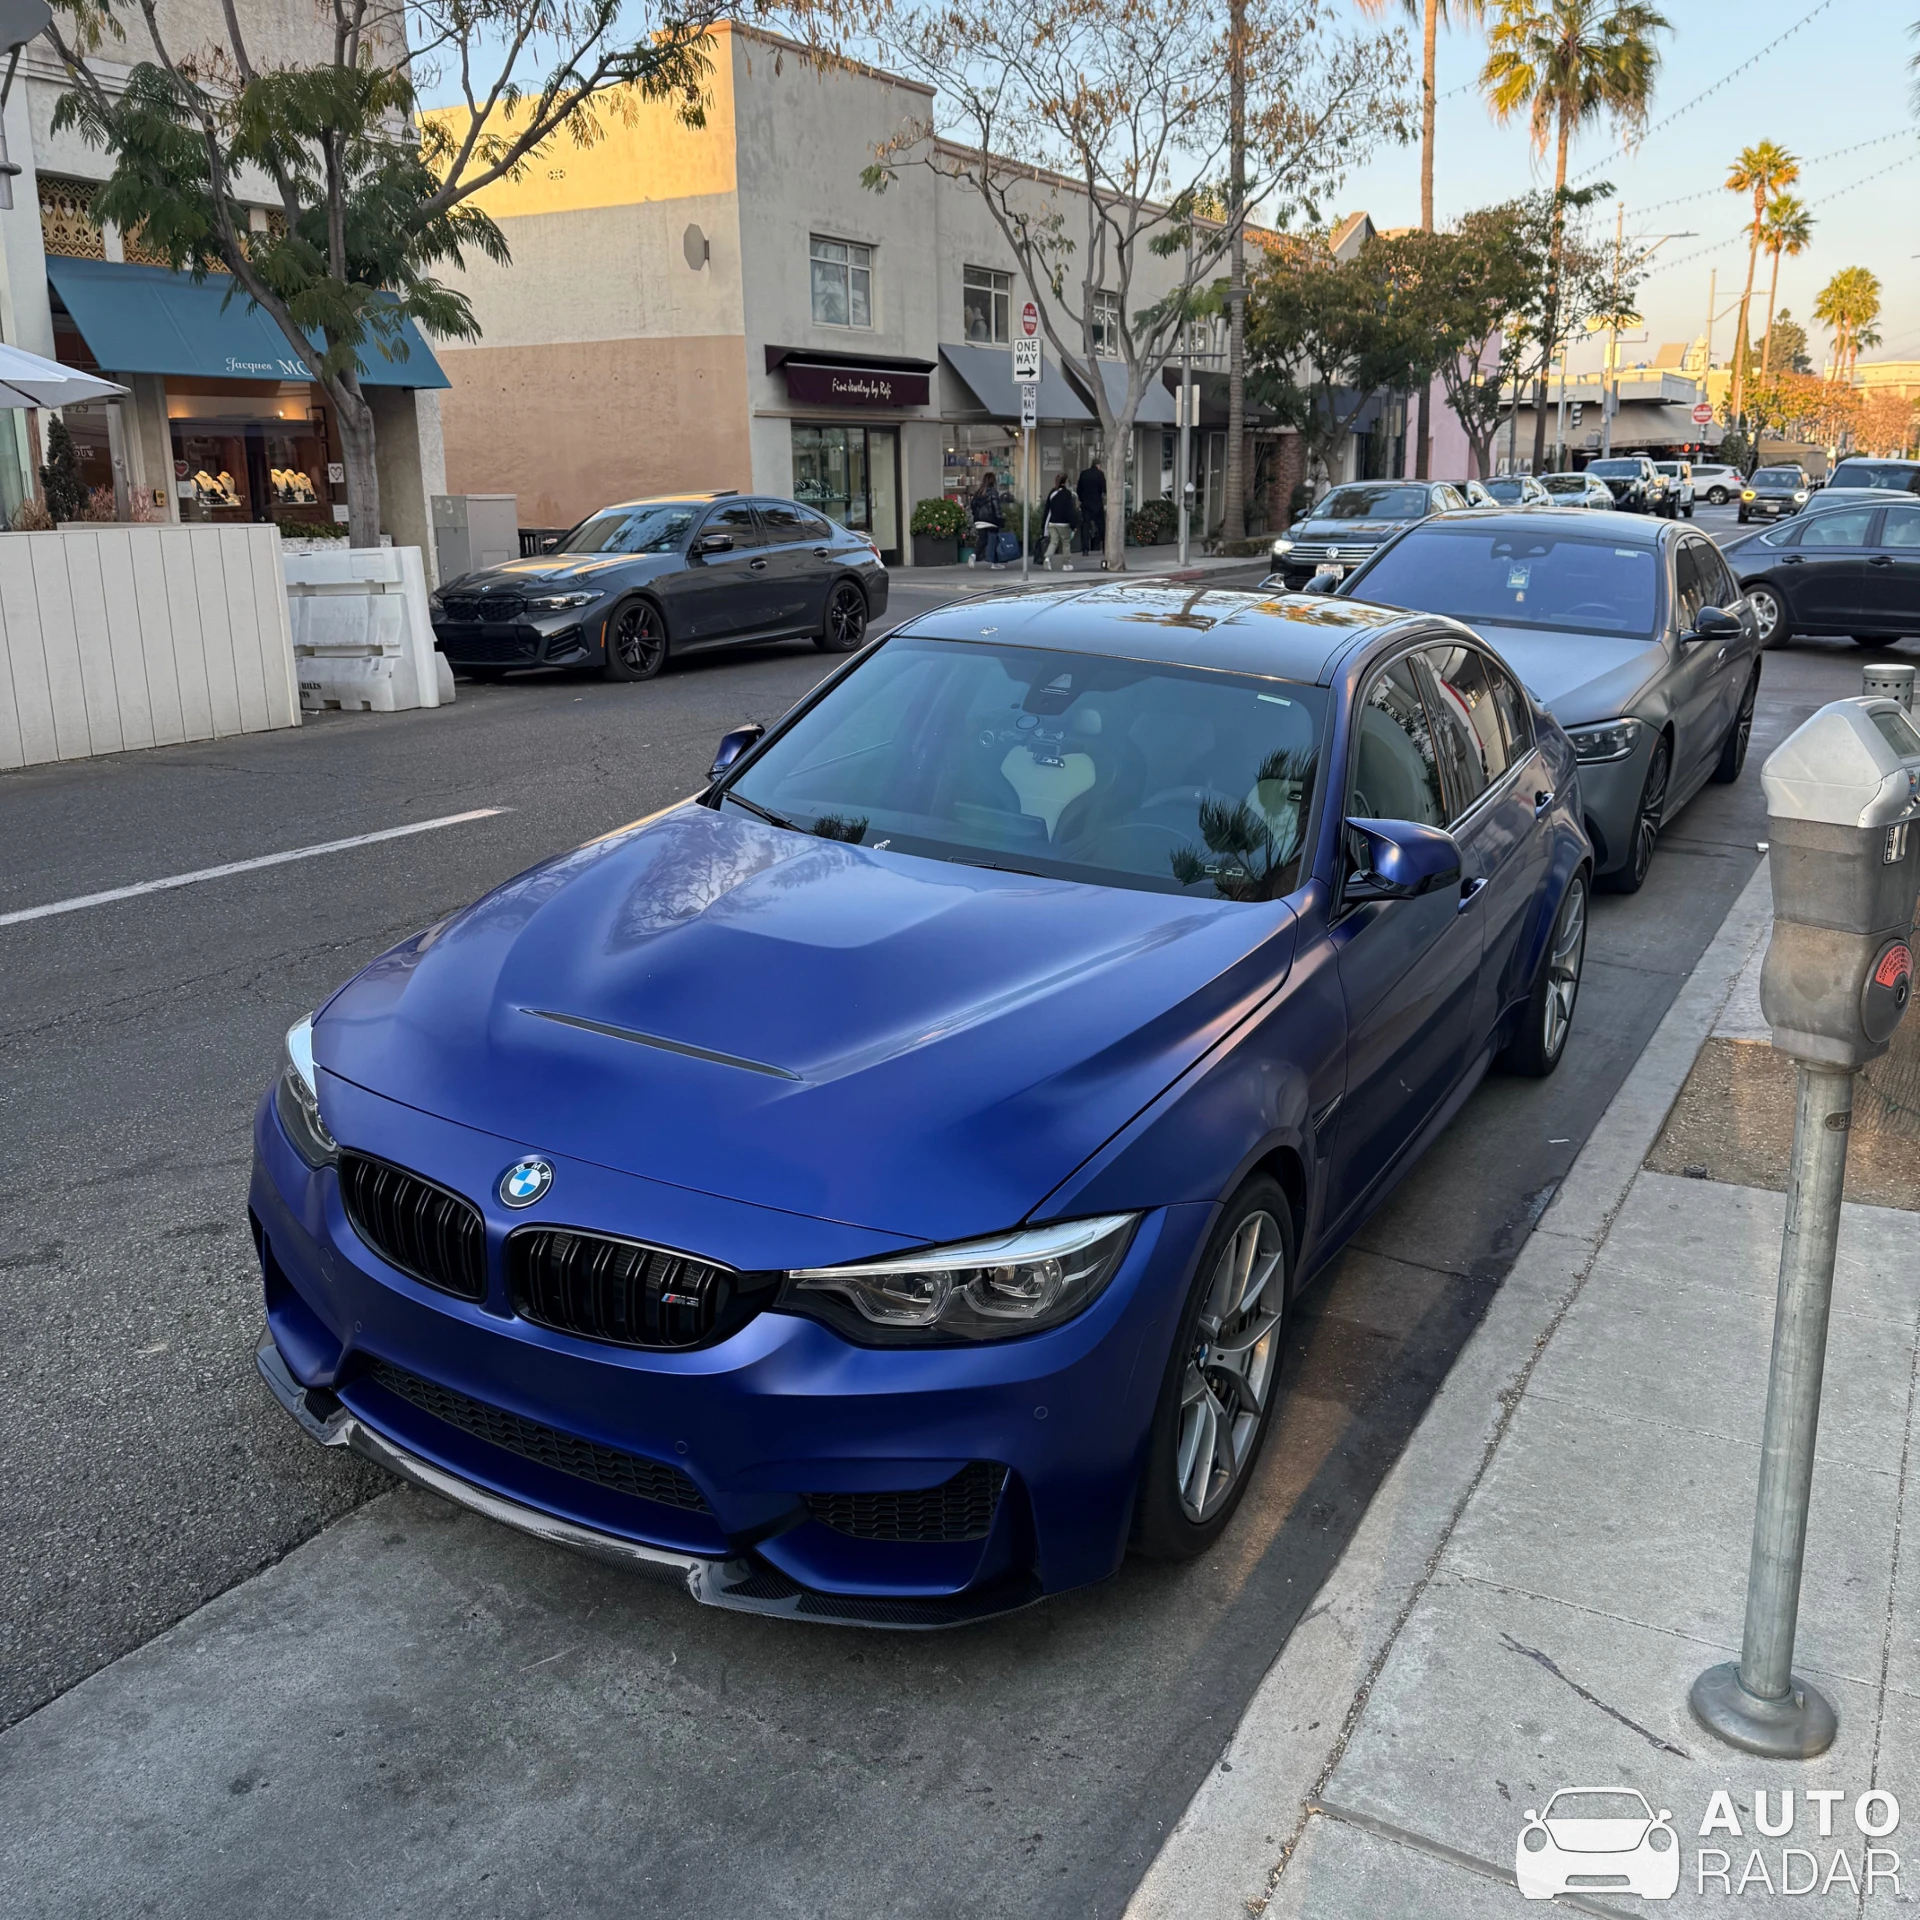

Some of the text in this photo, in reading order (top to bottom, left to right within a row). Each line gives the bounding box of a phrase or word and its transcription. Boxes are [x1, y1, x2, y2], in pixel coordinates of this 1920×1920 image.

[1024, 322, 1036, 330] ENTER
[1016, 341, 1037, 352] ONE
[1016, 353, 1037, 364] WAY
[225, 357, 273, 374] Jacques
[832, 377, 847, 393] Fine
[871, 380, 879, 399] by
[1023, 386, 1035, 398] ONE
[1023, 400, 1035, 410] WAY
[1886, 828, 1894, 861] COINS
[515, 1162, 550, 1180] BMW
